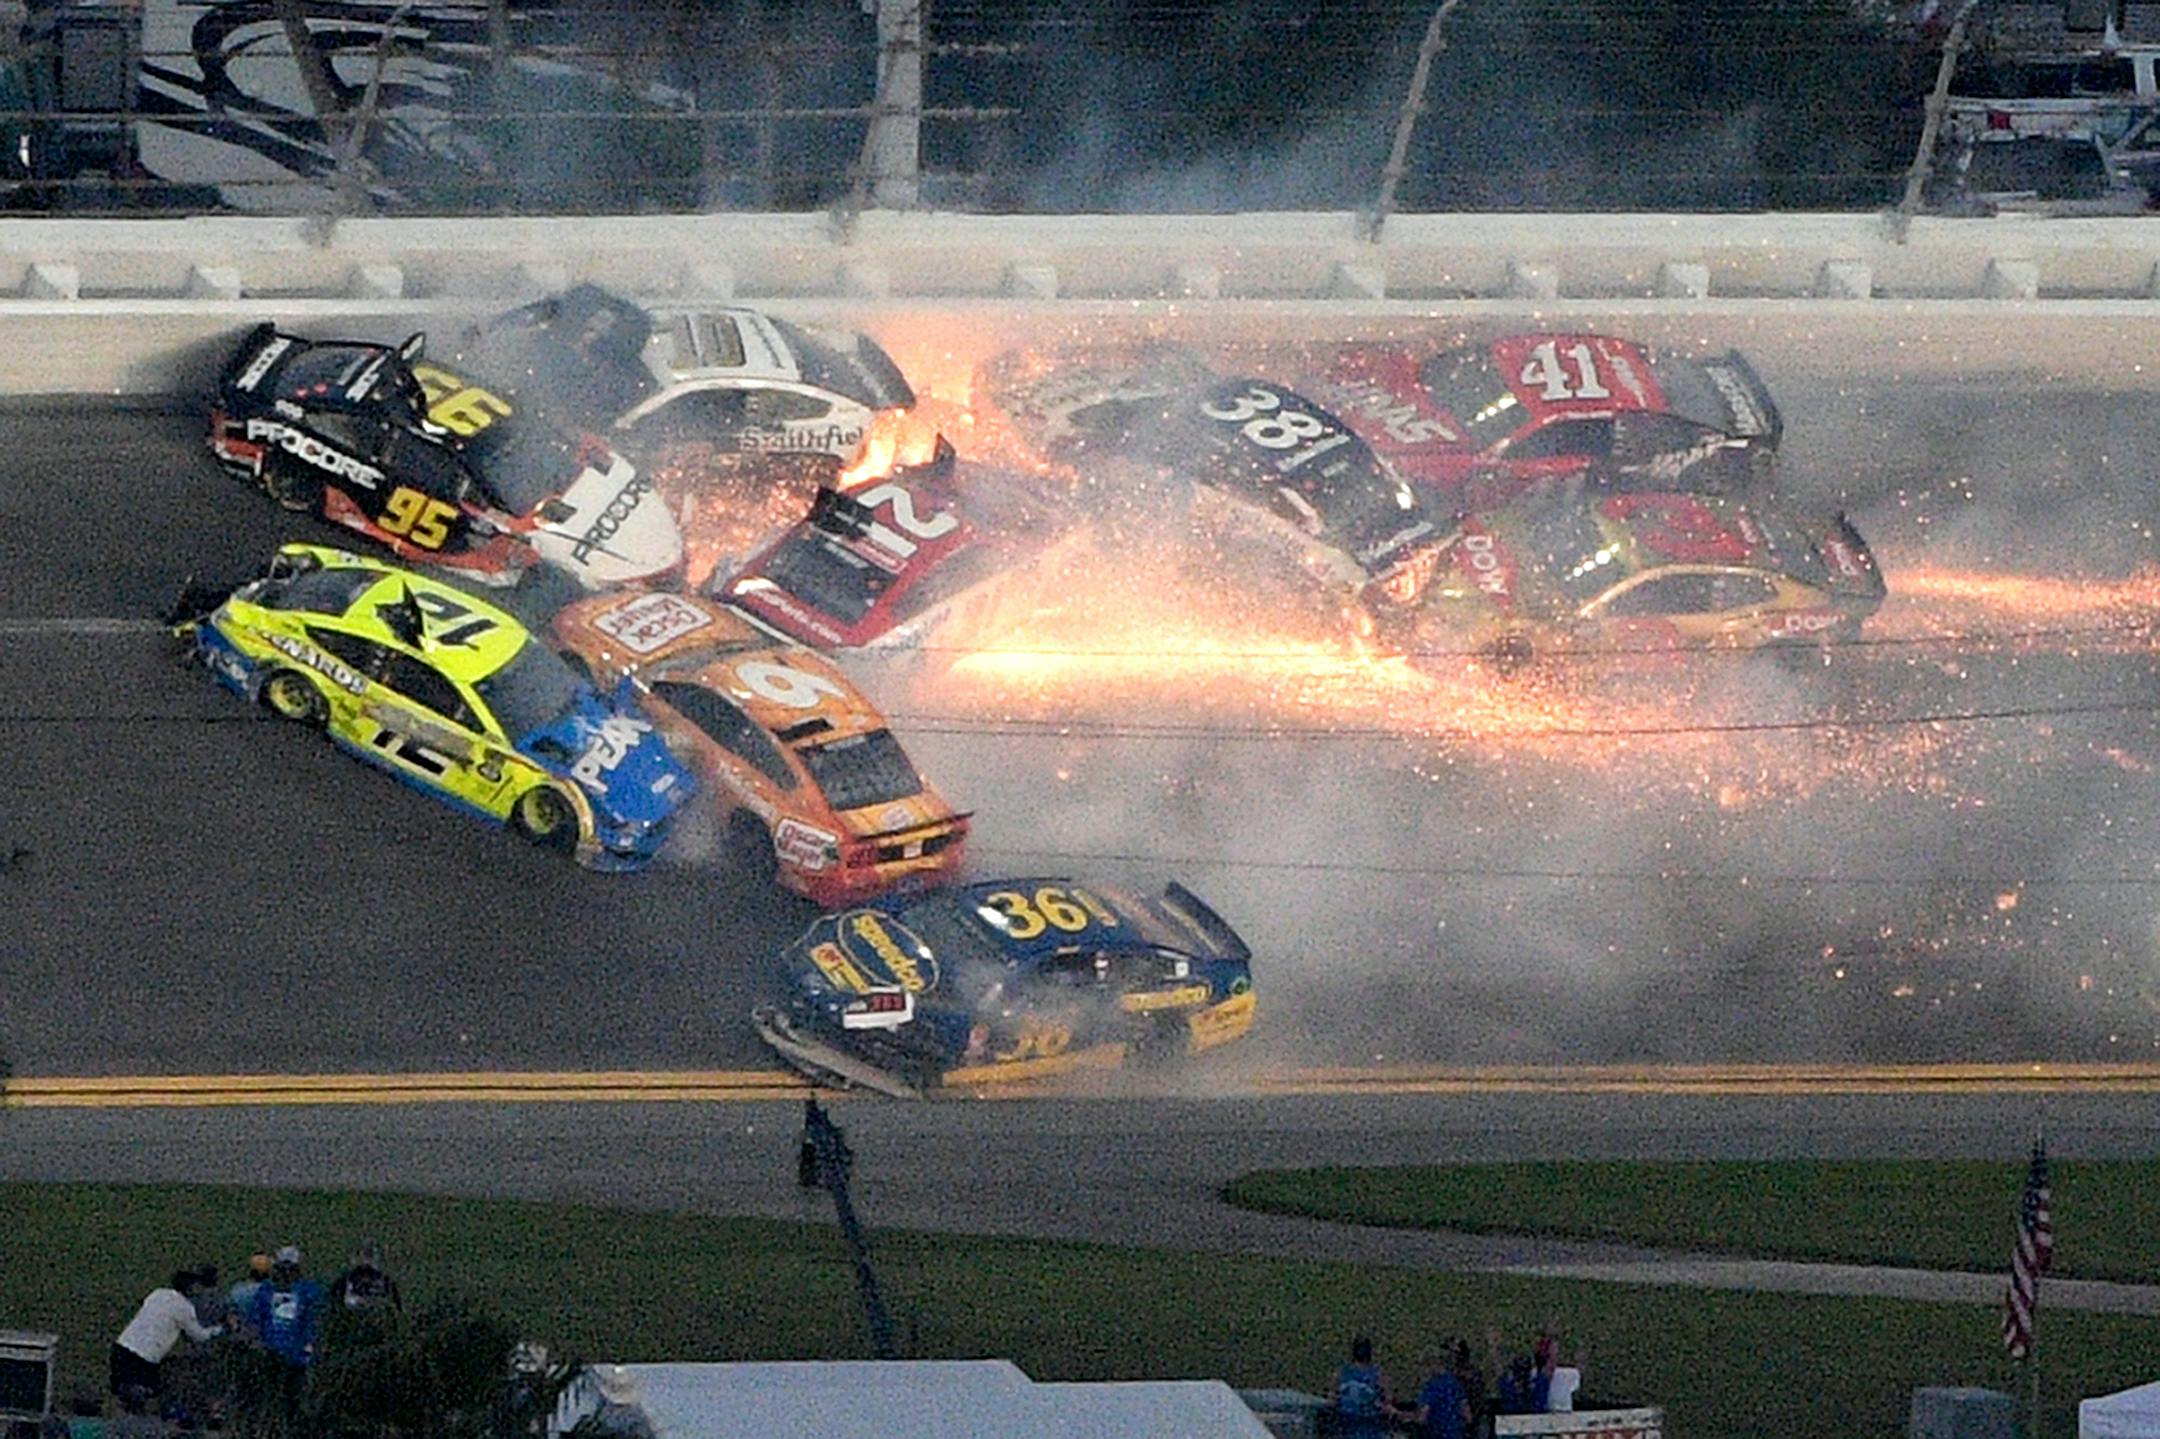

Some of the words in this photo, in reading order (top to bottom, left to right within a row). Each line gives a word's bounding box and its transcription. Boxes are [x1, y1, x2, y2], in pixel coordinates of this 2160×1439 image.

[1520, 341, 1610, 401] 41
[1200, 387, 1323, 449] 38
[246, 417, 386, 491] PROCORE
[377, 485, 460, 550] 95
[735, 660, 847, 708] 6
[572, 712, 654, 793] PEAK
[987, 888, 1090, 939] 36
